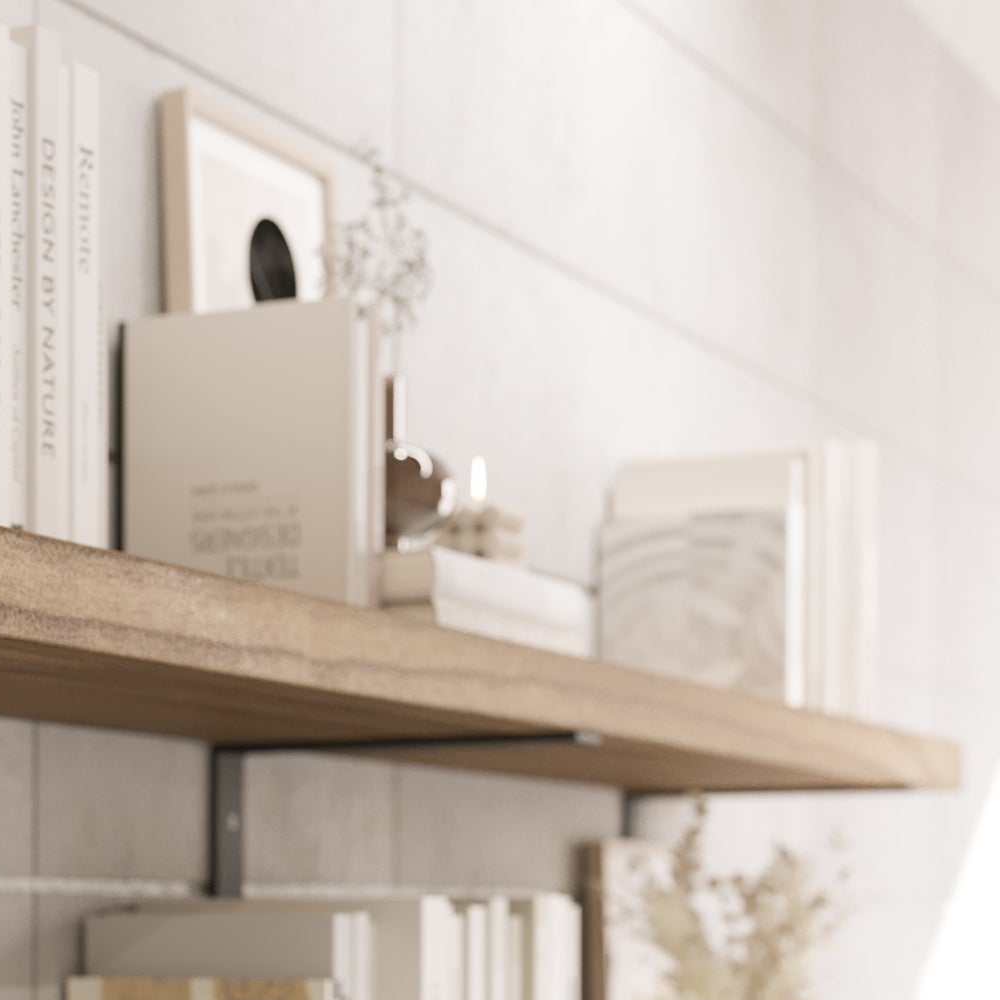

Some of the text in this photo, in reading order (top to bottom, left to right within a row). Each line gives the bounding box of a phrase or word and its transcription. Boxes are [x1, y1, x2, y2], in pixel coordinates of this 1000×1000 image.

[8, 95, 25, 158] John
[40, 137, 56, 460] DESIGN BY NATURE
